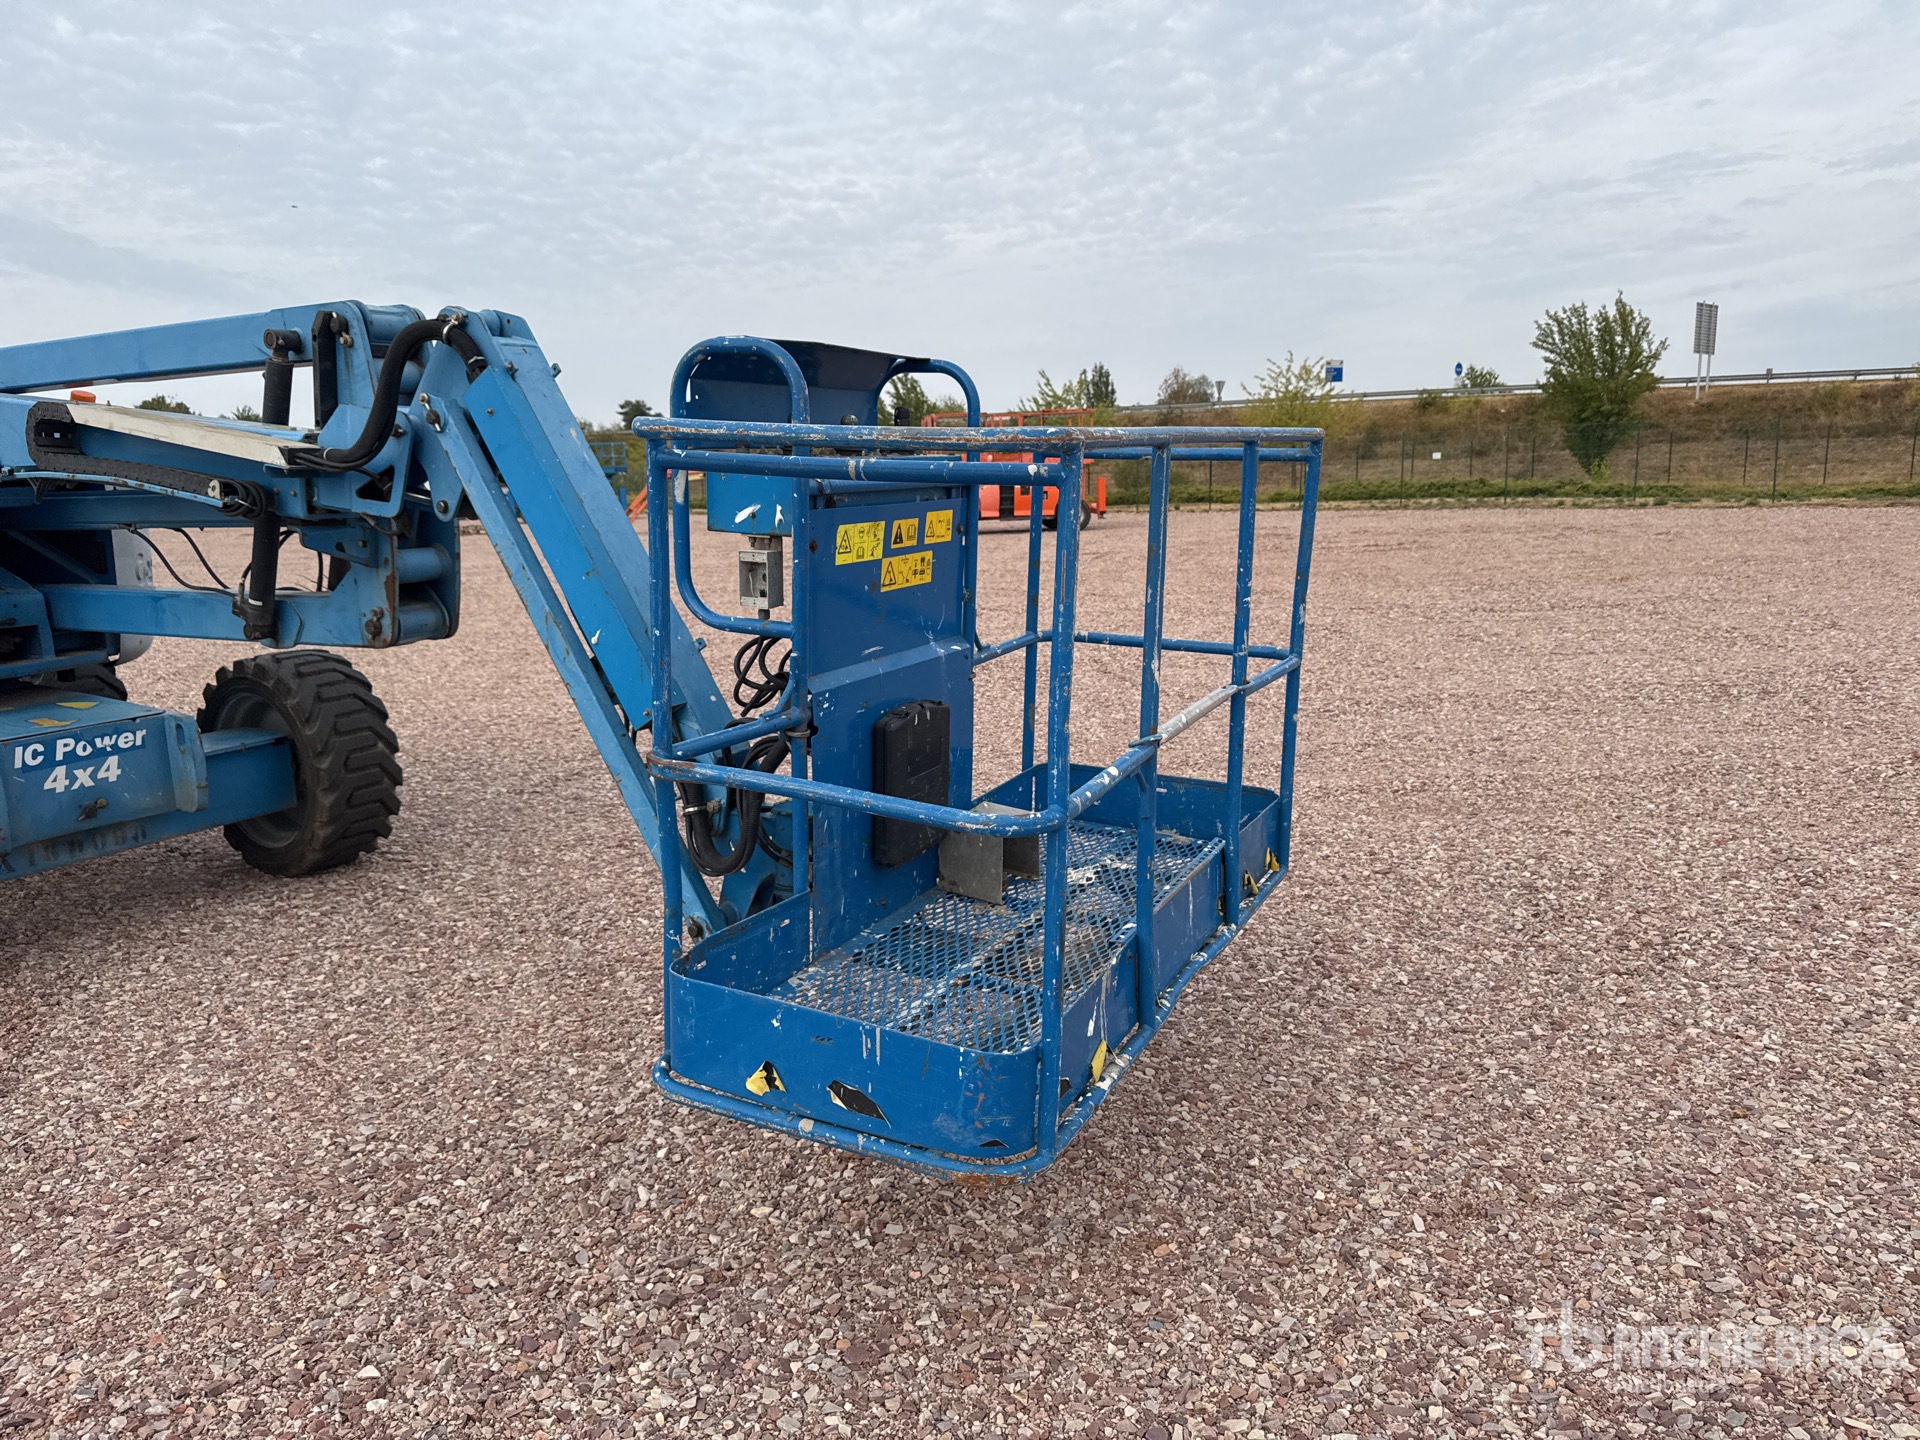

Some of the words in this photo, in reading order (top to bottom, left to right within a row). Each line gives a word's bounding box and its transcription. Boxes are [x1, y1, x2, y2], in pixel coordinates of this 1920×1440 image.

[14, 743, 45, 769] IC
[55, 729, 147, 761] Power
[43, 755, 122, 793] 4x4
